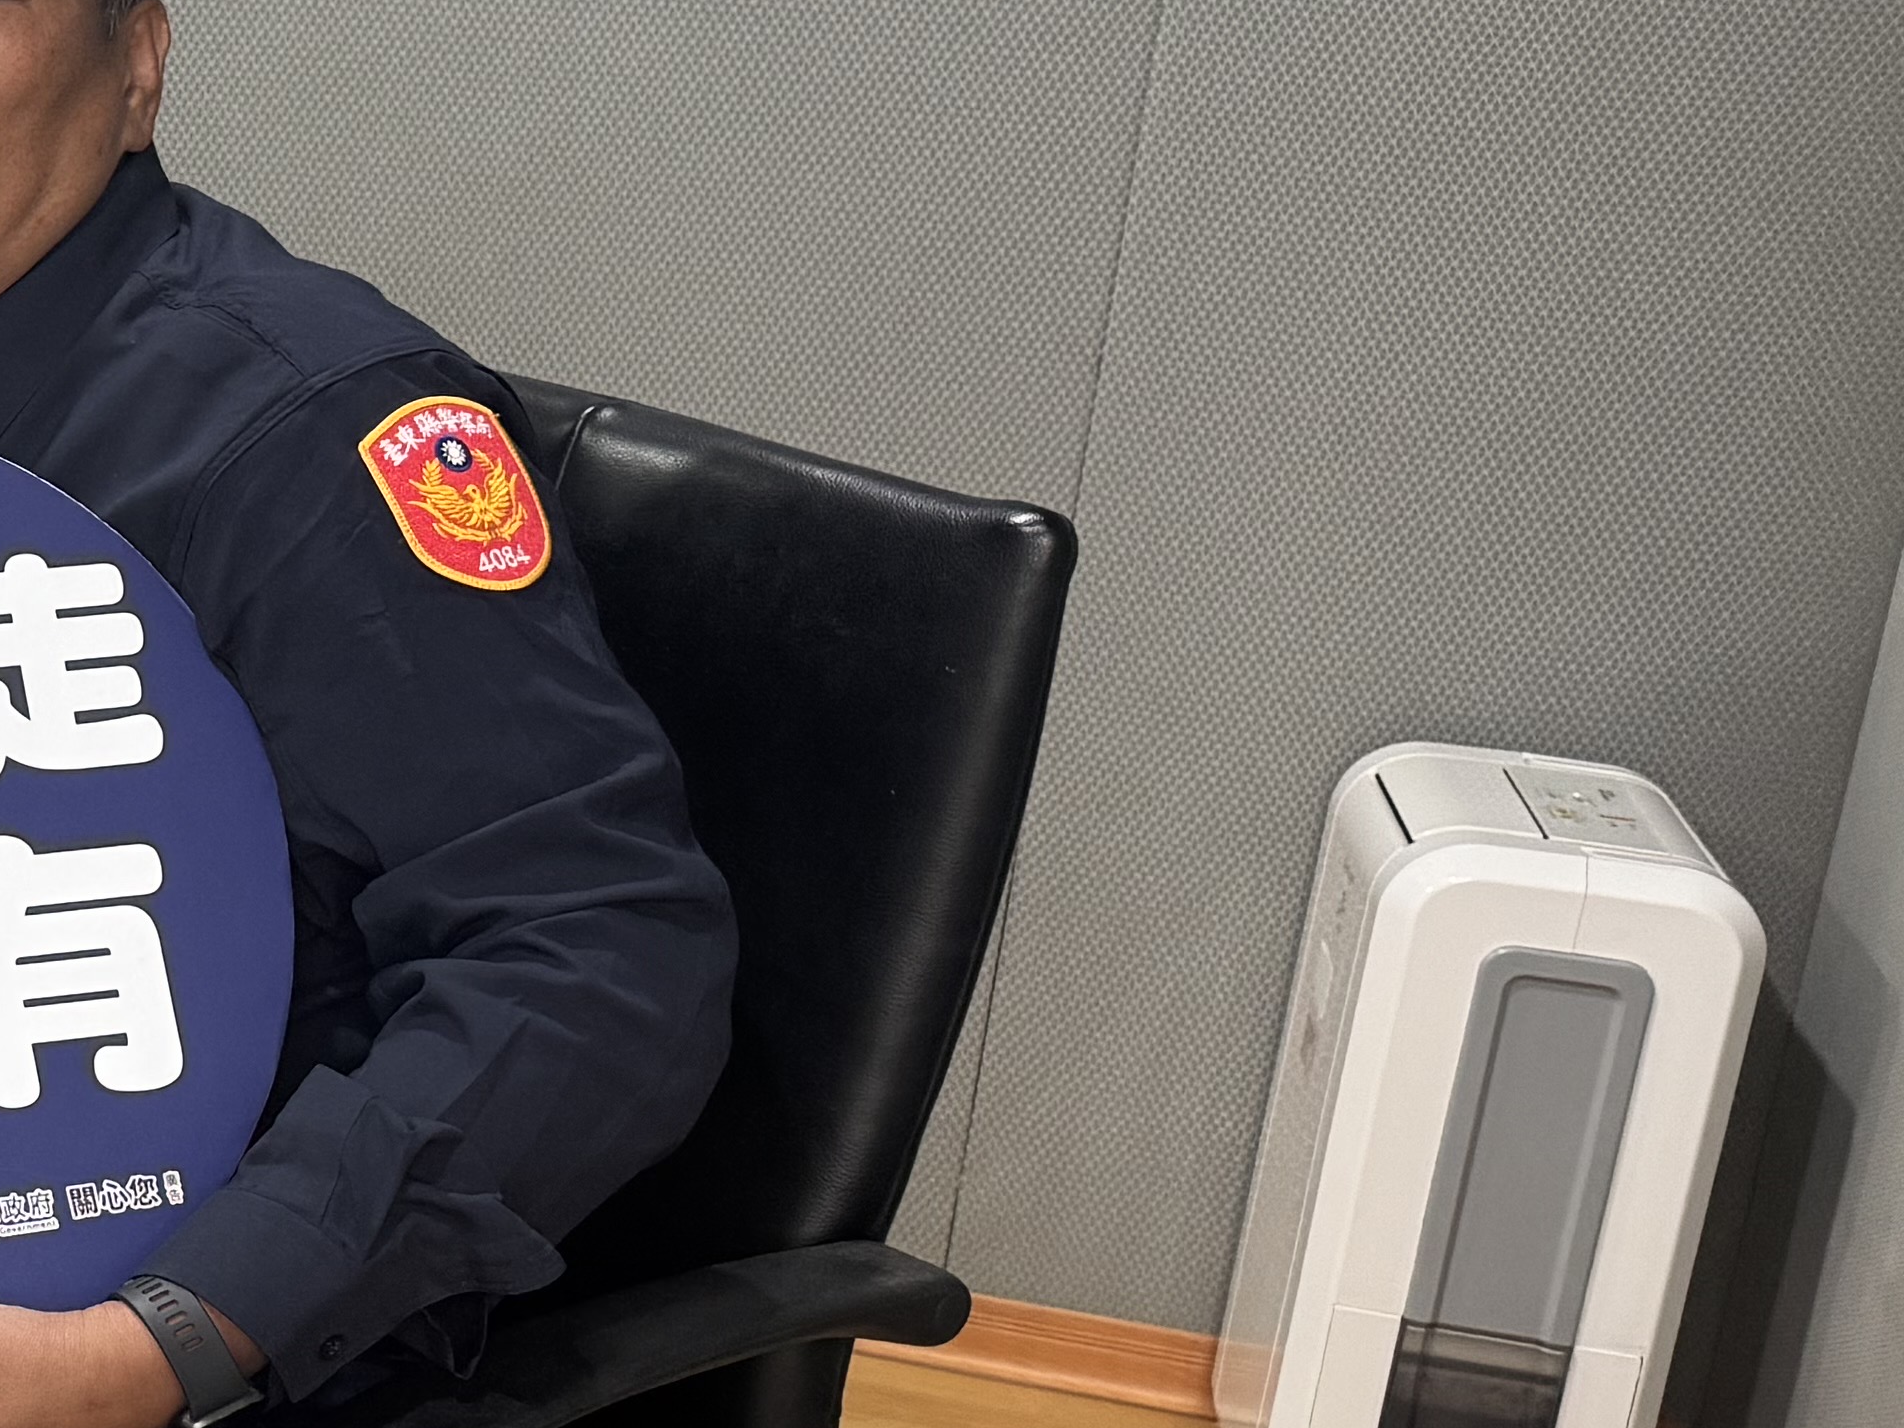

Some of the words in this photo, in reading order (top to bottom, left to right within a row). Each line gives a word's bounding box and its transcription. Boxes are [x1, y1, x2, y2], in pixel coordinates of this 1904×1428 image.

[479, 544, 531, 573] 4084
[69, 1176, 159, 1218] 關心您
